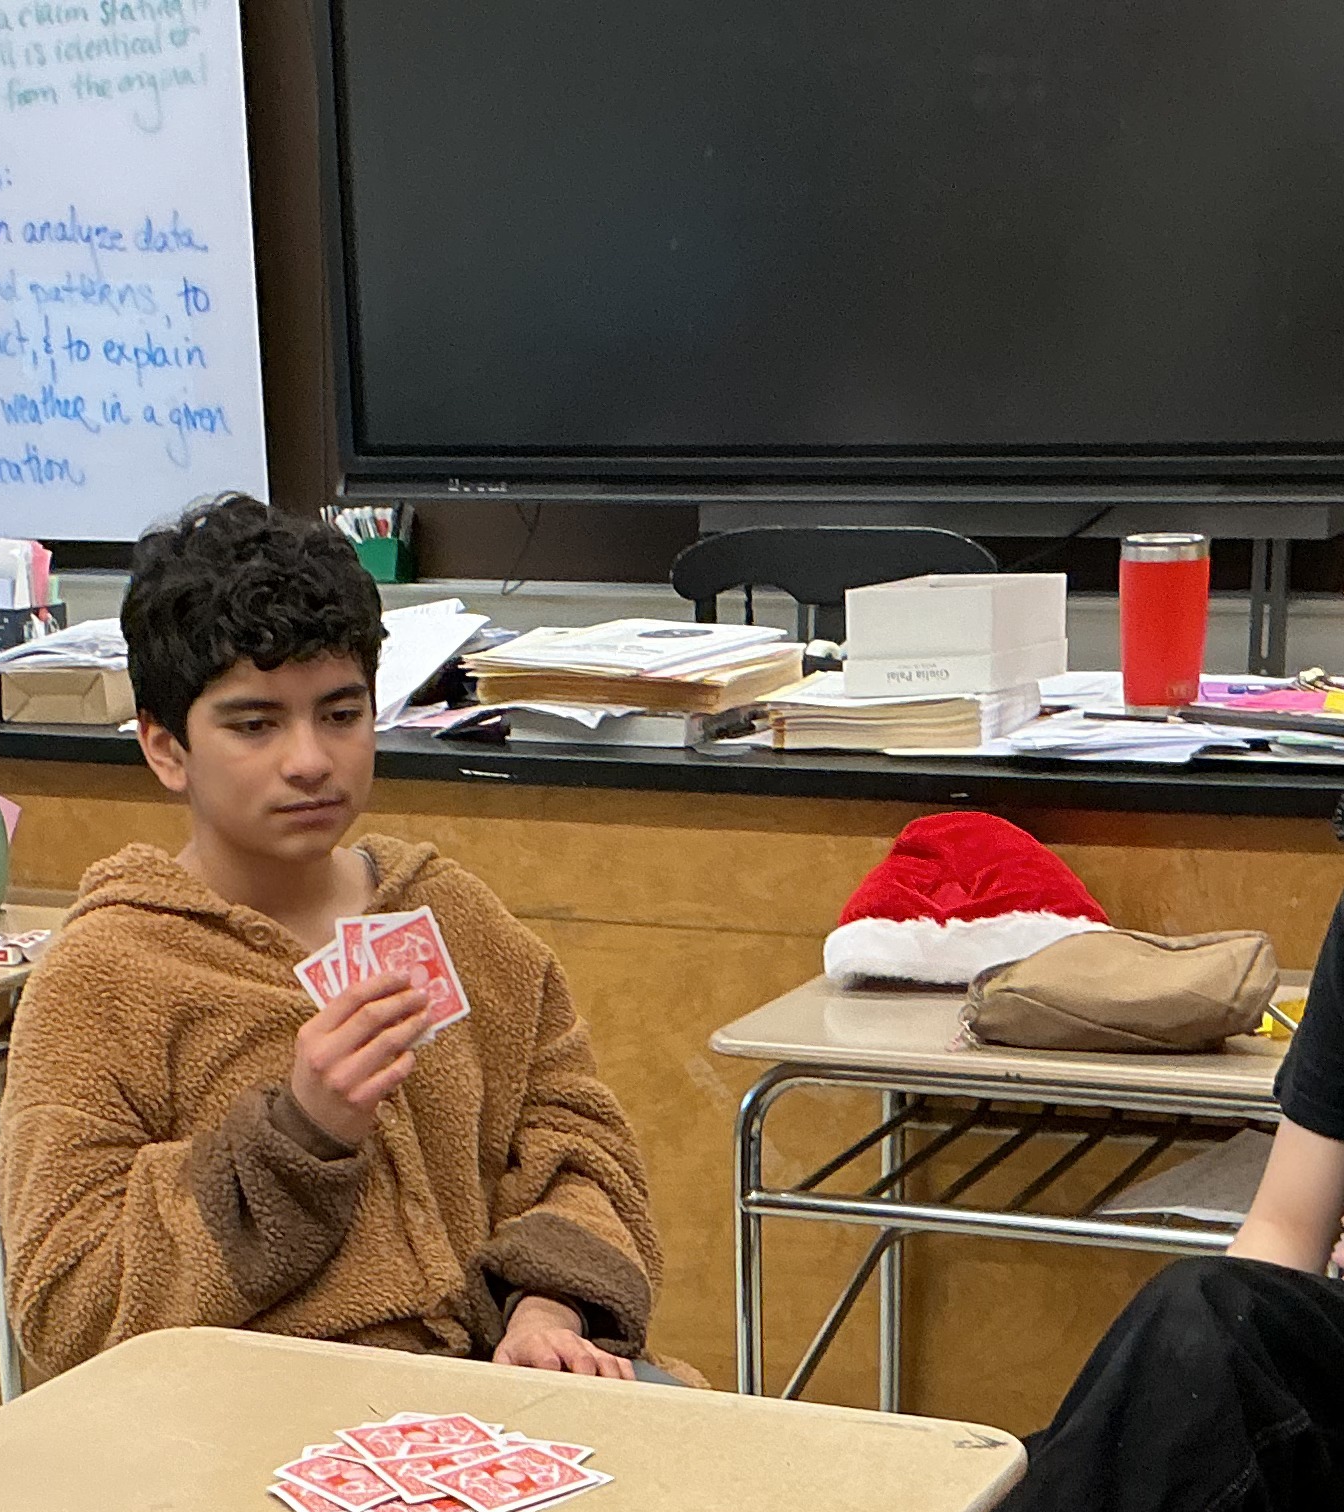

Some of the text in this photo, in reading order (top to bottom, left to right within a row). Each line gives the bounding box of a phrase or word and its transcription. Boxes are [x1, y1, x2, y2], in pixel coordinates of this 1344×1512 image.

[24, 40, 48, 66] is
[179, 277, 210, 317] to
[64, 326, 90, 363] to
[103, 332, 207, 387] explain
[103, 394, 131, 423] in
[144, 407, 157, 424] a
